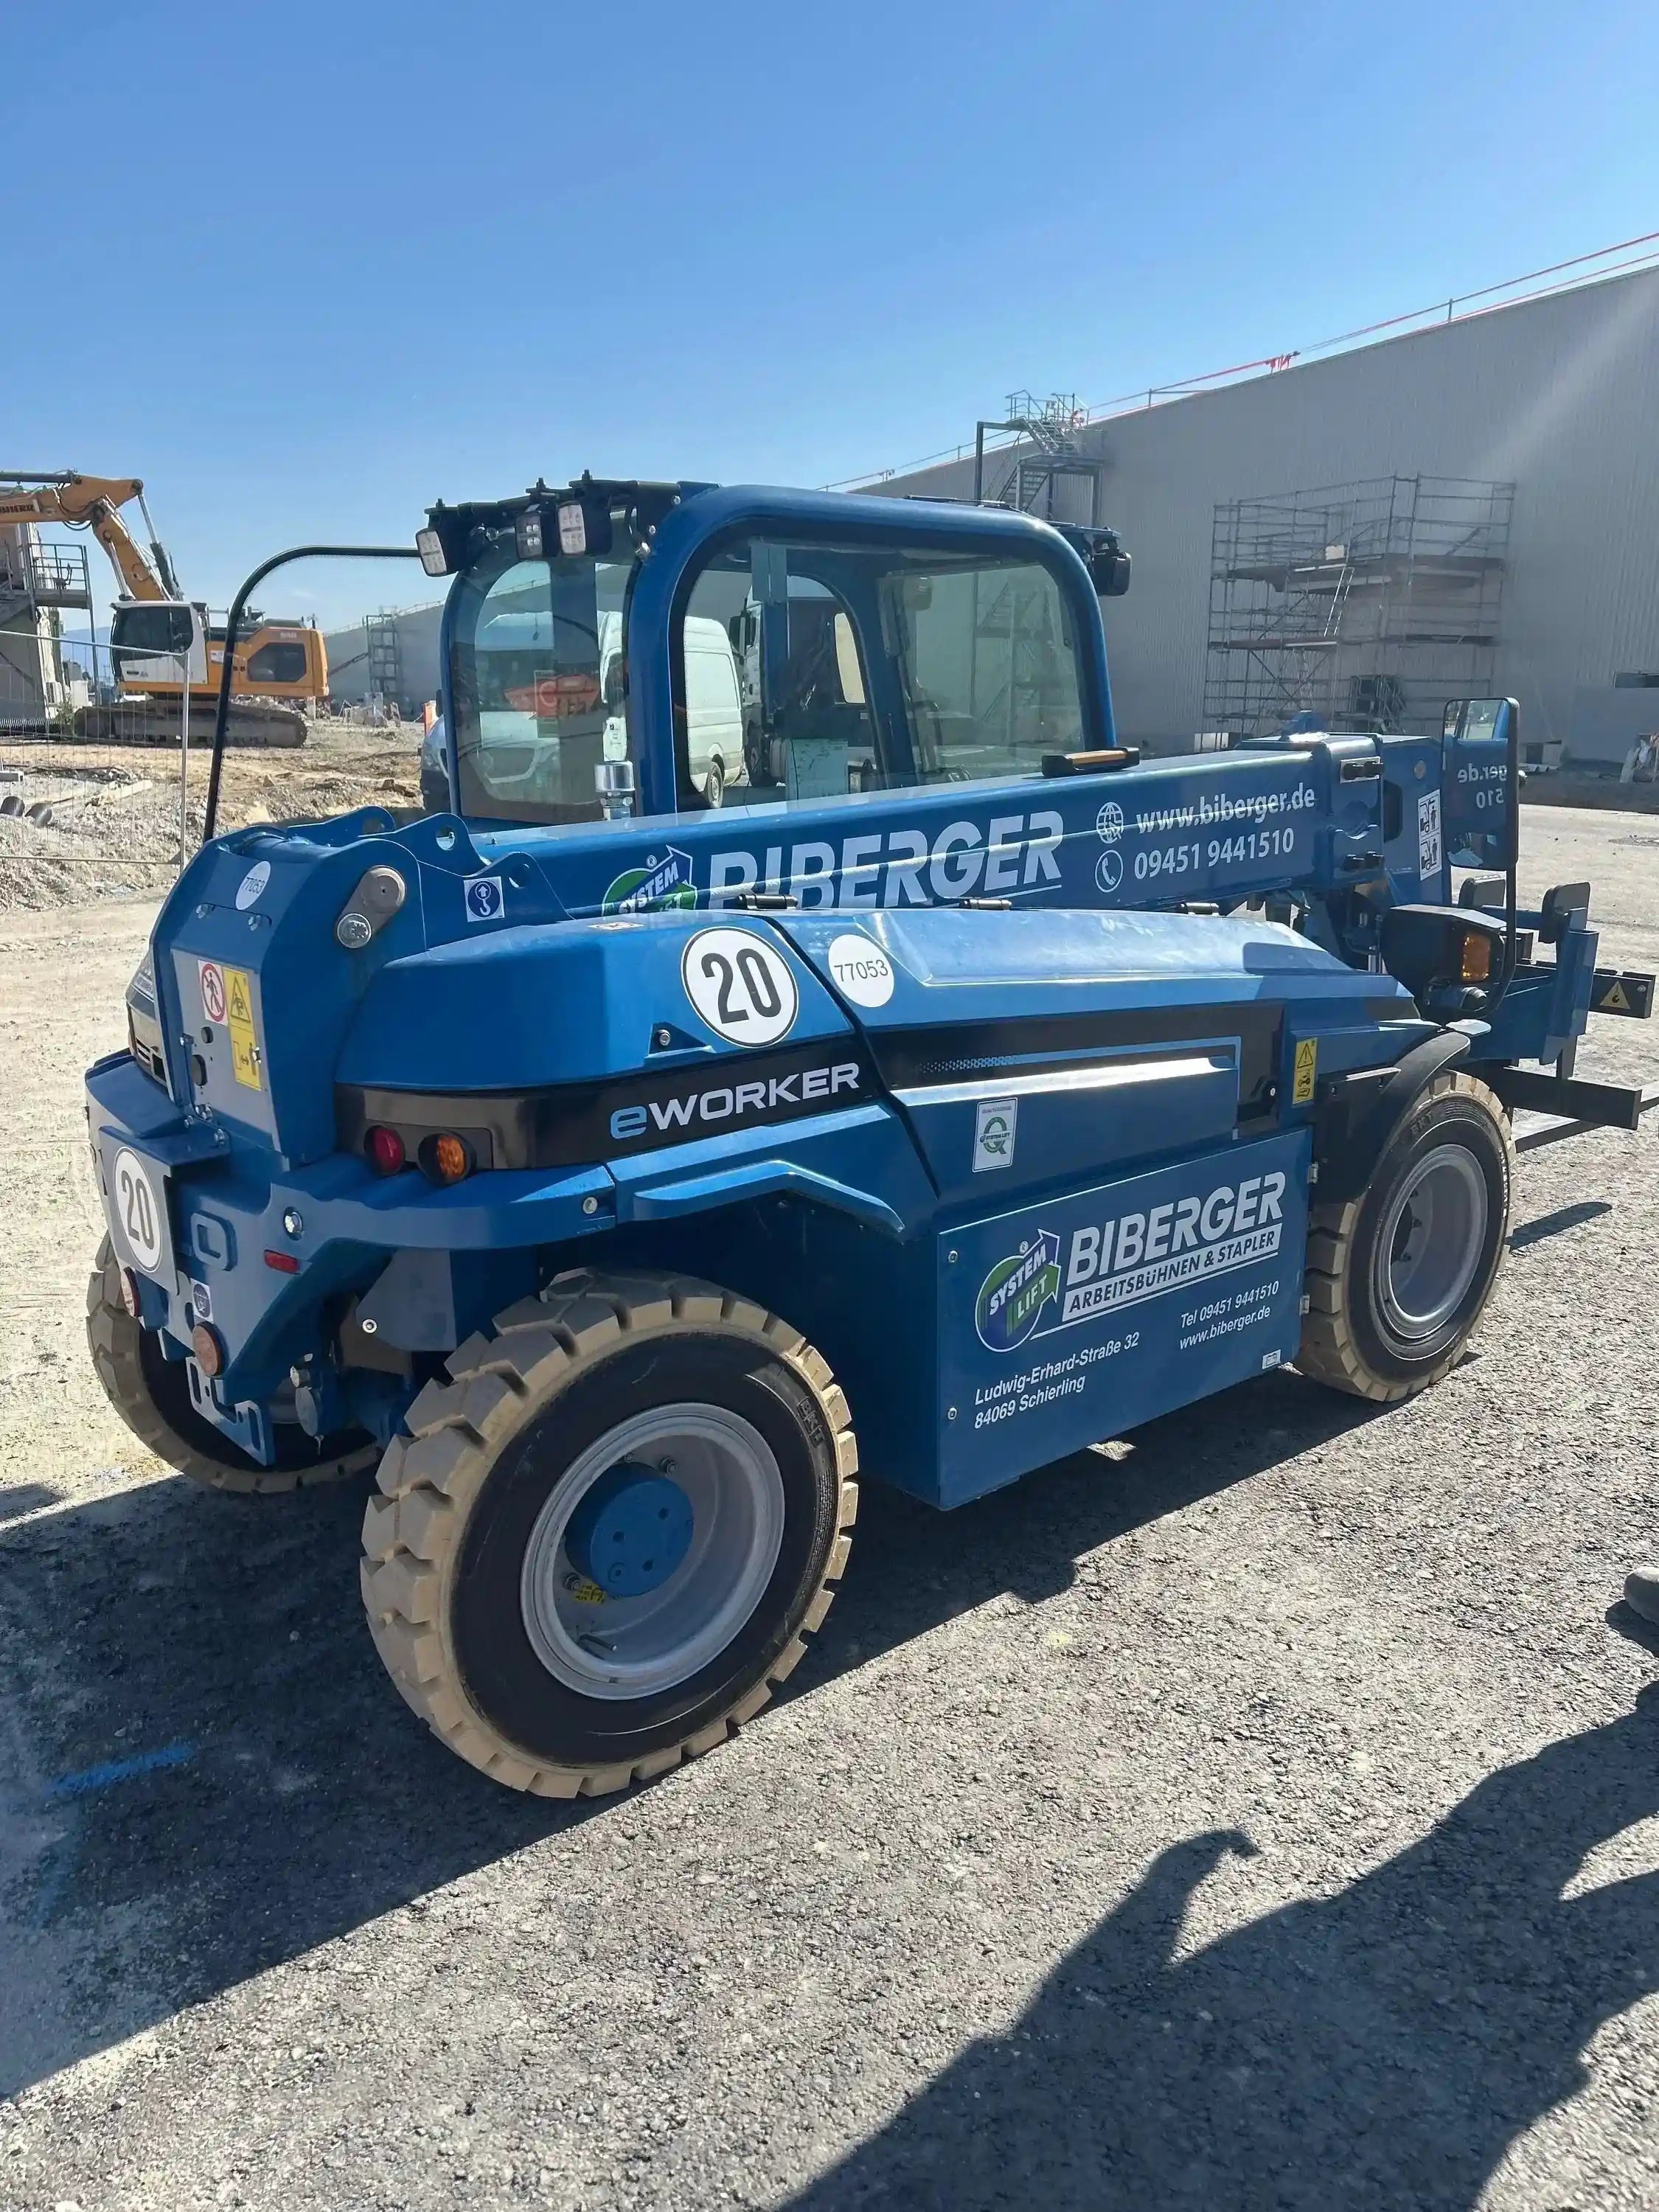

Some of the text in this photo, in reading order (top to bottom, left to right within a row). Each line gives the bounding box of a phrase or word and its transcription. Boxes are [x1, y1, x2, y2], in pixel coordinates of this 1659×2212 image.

[1136, 782, 1315, 834] www.biberger.de
[708, 810, 1064, 908] BIBERGER
[1134, 827, 1294, 880] 09451 9441510
[701, 948, 782, 1023] 20
[834, 959, 888, 981] 77053
[611, 1062, 860, 1139] eWORKER
[121, 1170, 154, 1250] 20
[1066, 1171, 1286, 1286] BIBERGER
[989, 1243, 1047, 1315] SYSTEM
[1018, 1273, 1047, 1319] LIFT
[1069, 1231, 1276, 1312] ARBEITSBÜHNEN & STAPLER
[1180, 1280, 1279, 1328] Tel 09451 9441510
[1180, 1305, 1271, 1350] www.biberger.de
[974, 1375, 1086, 1429] 84069 Schierling
[975, 1332, 1139, 1405] Ludwig-Erhard-Straße 32
